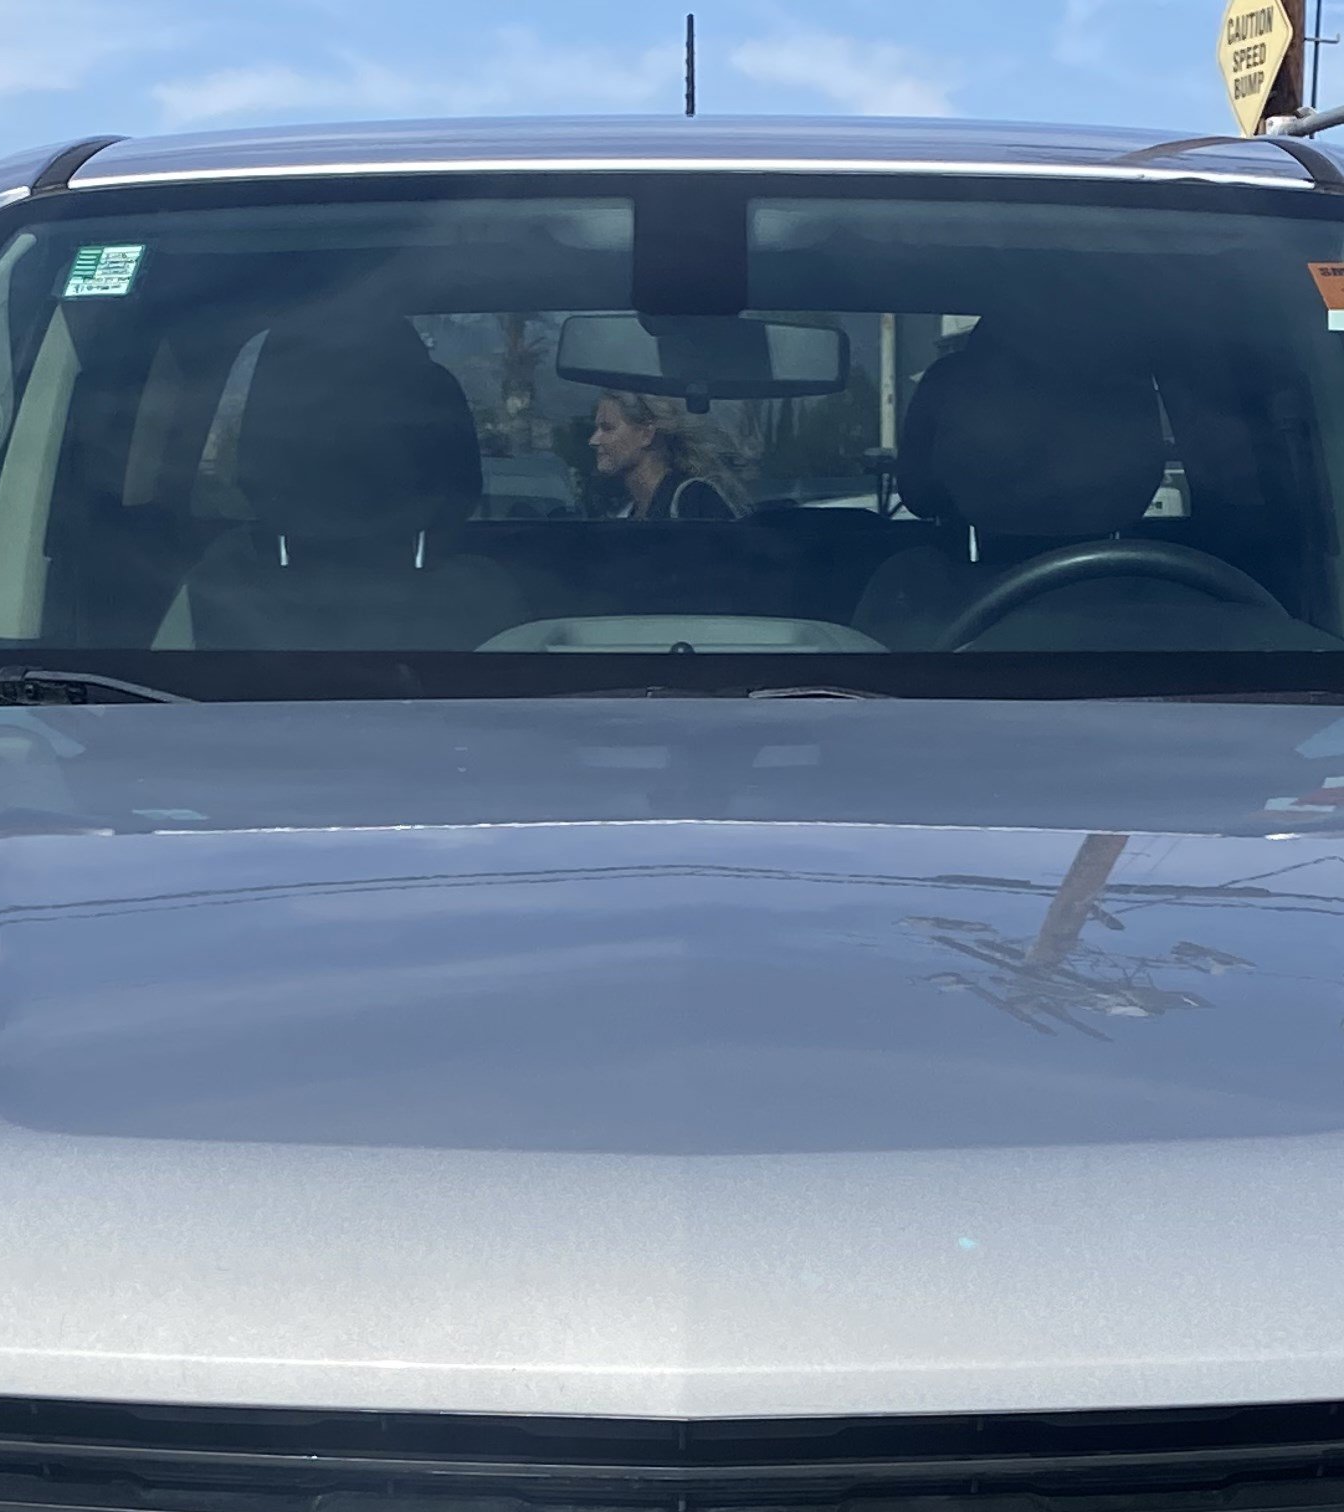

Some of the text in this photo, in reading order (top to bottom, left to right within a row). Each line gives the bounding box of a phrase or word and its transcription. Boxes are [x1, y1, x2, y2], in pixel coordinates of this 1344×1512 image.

[1227, 5, 1273, 45] CAUTION
[1233, 42, 1266, 73] SPEED
[1234, 70, 1264, 100] BUMP
